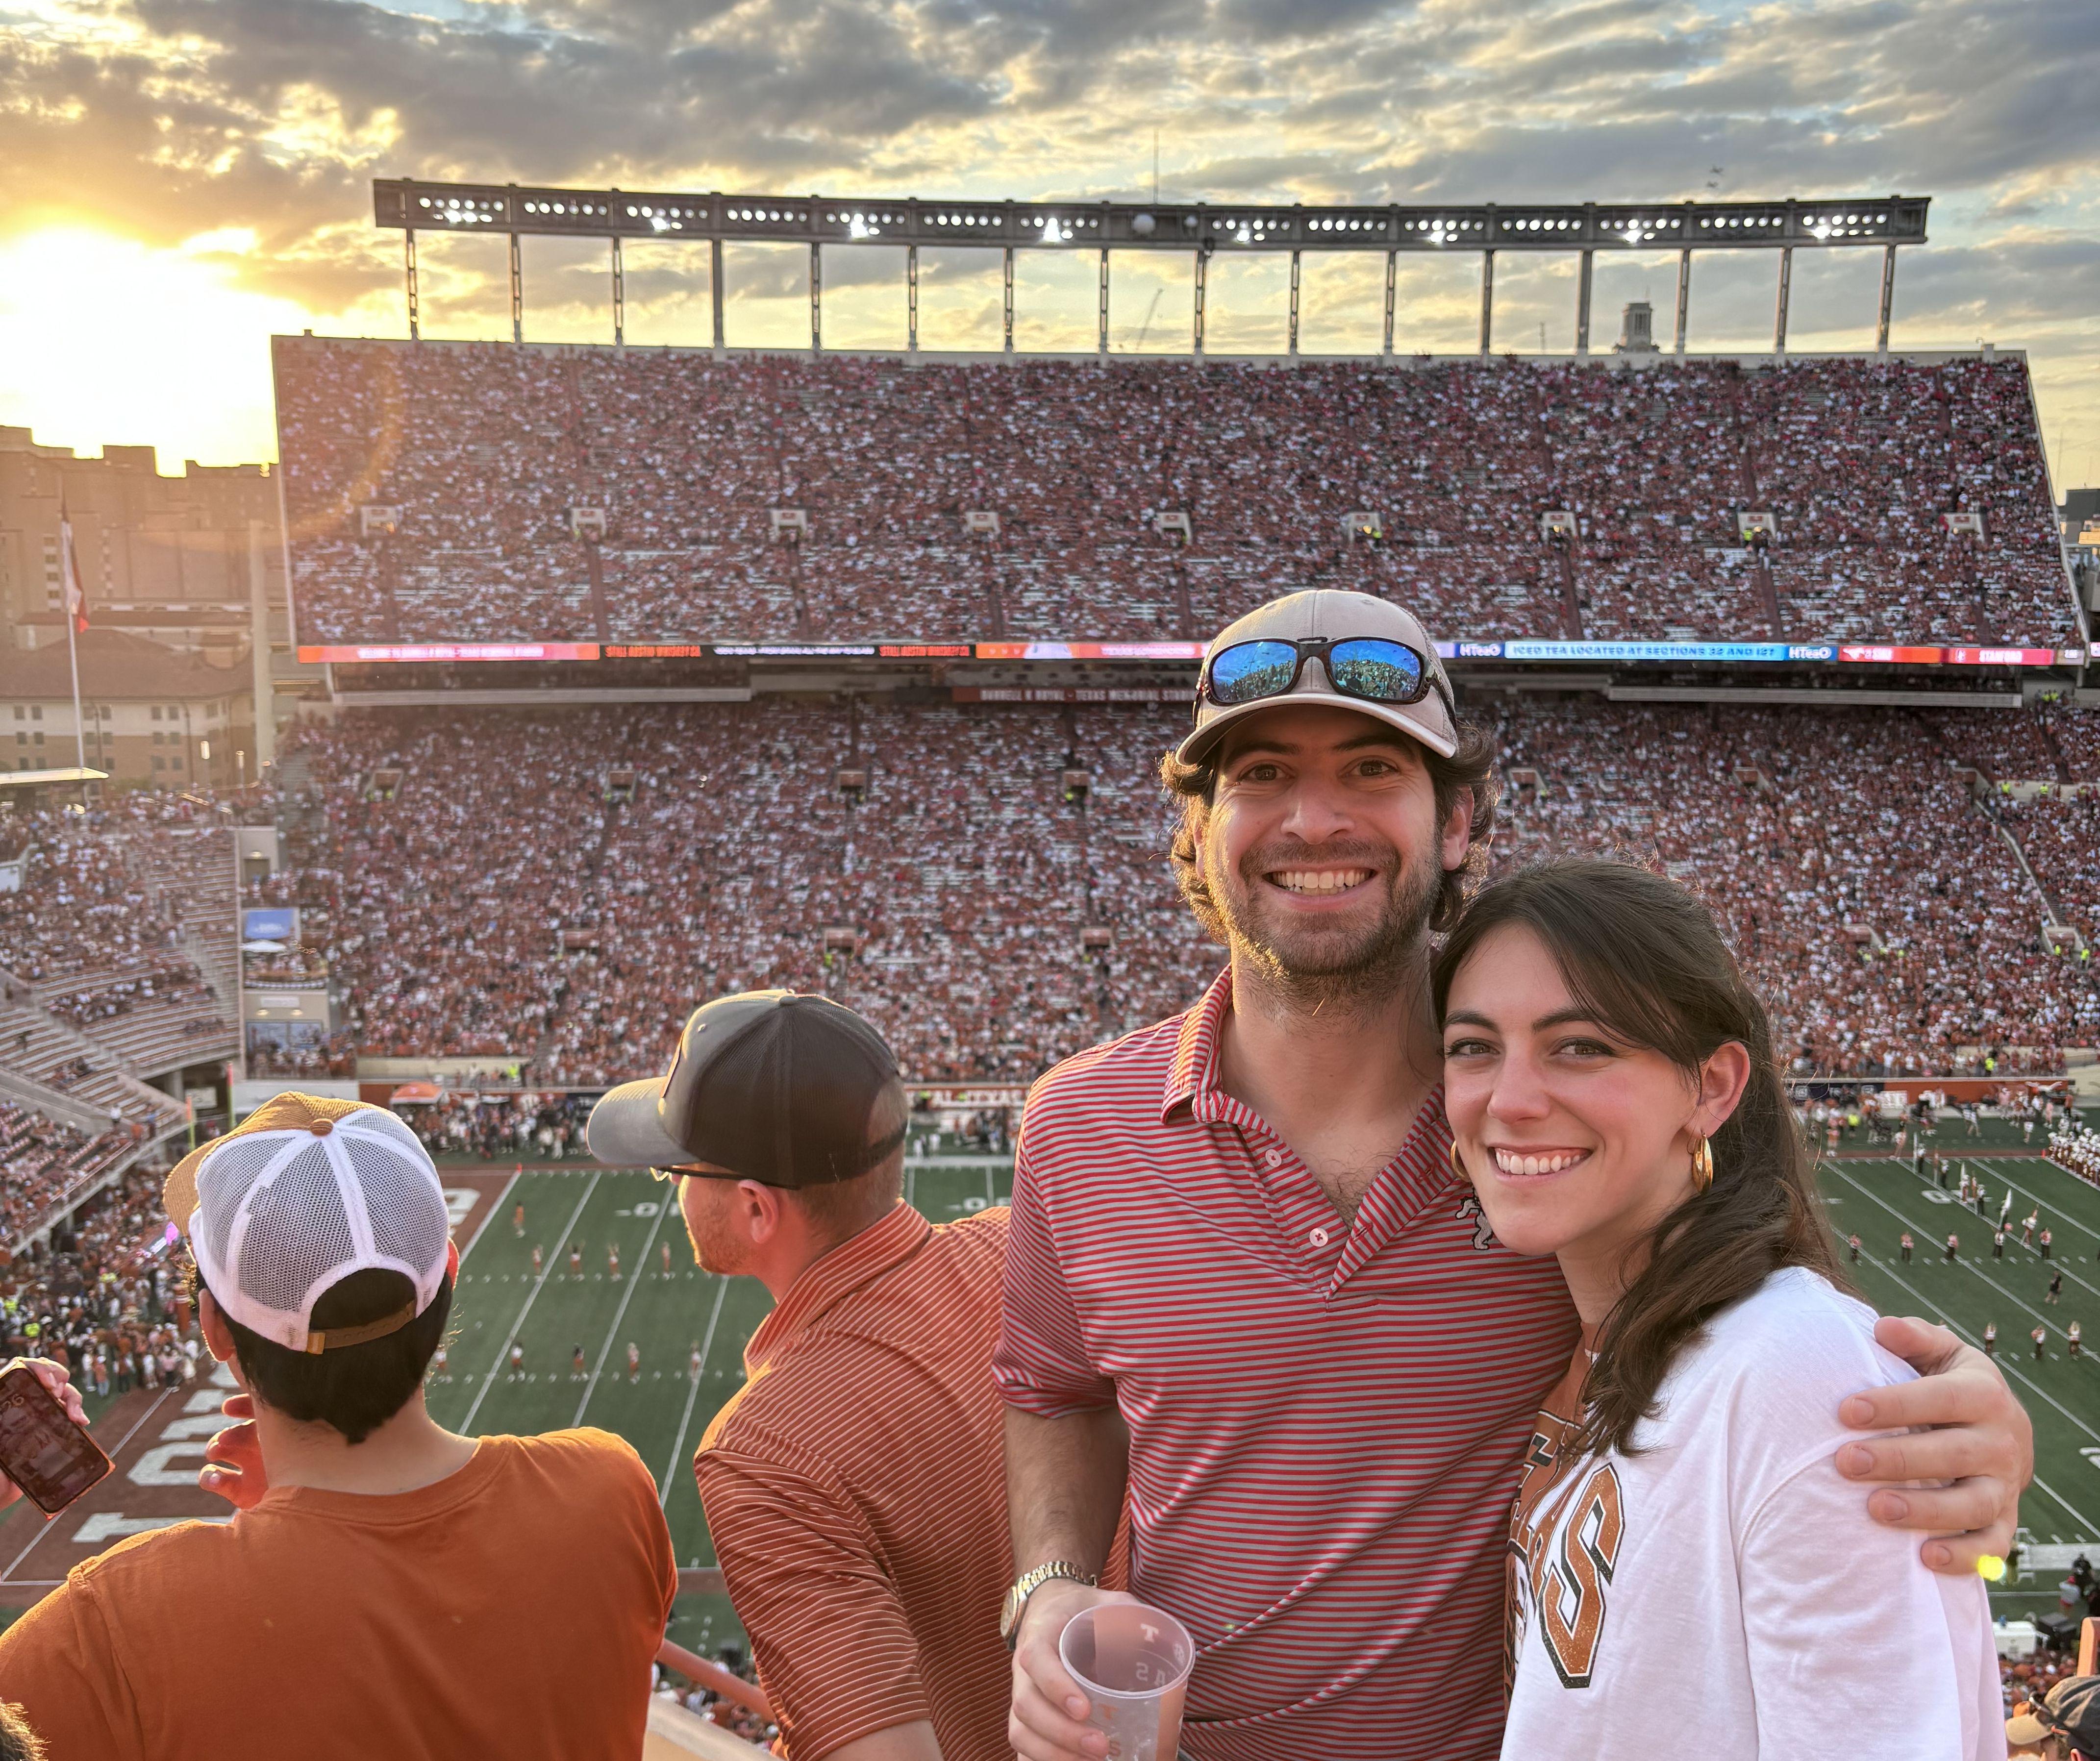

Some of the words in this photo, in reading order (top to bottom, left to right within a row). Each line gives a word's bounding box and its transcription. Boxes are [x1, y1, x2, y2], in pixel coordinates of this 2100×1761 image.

[1460, 644, 1500, 656] HTeaO
[1513, 646, 1542, 655] ICED
[1546, 646, 1567, 655] TEA
[1571, 646, 1624, 655] LOCATED
[1627, 646, 1642, 655] AT
[1645, 646, 1705, 656] SECTIONS
[1708, 647, 1724, 656] 32
[1726, 647, 1752, 656] AND
[1789, 646, 1832, 659] HTeaO
[1075, 690, 1105, 701] TEXAS
[1108, 690, 1160, 701] MEMORIAL
